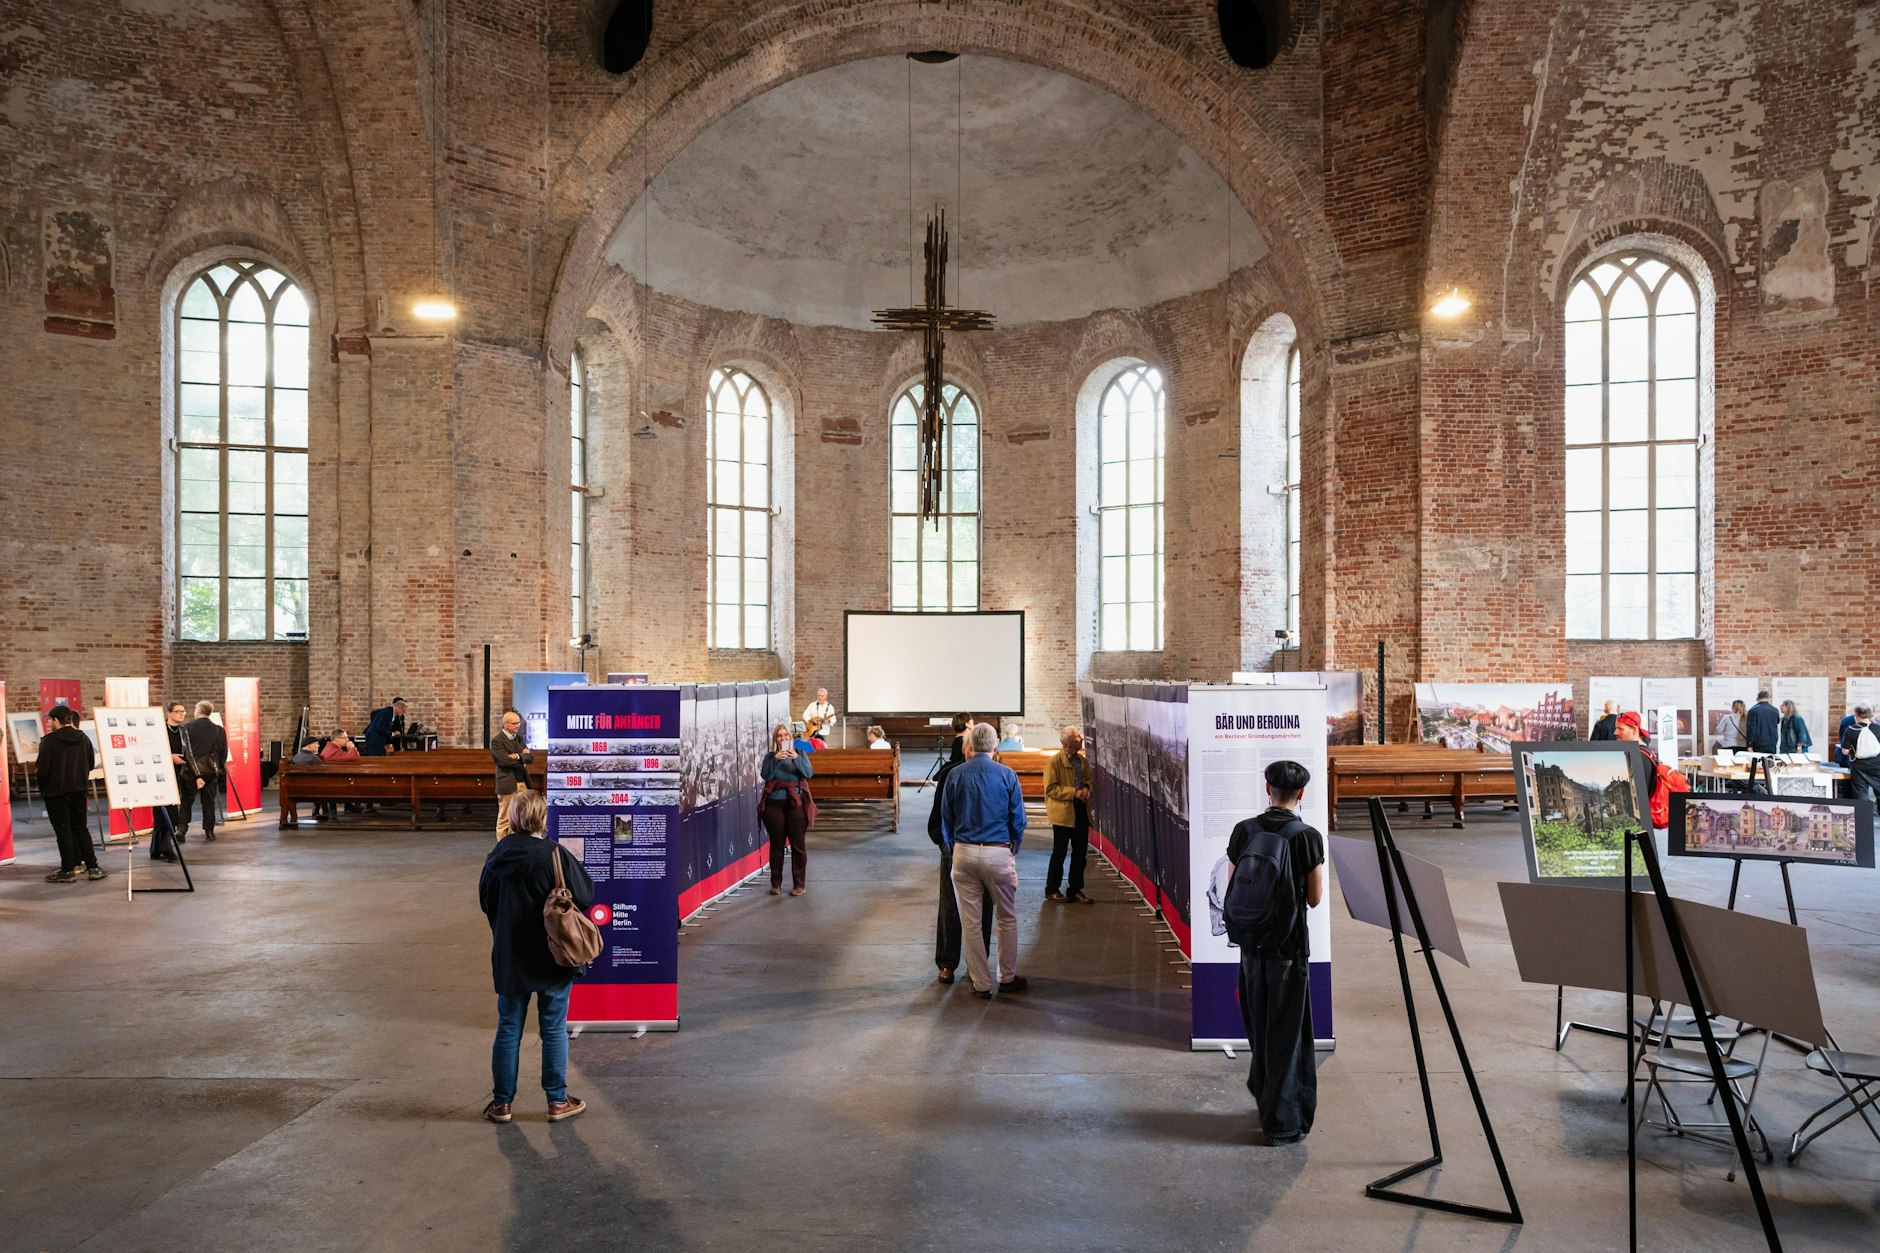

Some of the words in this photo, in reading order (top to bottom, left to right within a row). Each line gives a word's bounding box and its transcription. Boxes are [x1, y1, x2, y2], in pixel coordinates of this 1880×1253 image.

[567, 715, 594, 730] MITTE
[595, 712, 612, 730] FÜR
[614, 712, 661, 730] ANFÄNGER
[1215, 712, 1234, 730] BÄR
[1236, 715, 1255, 730] UND
[1257, 714, 1300, 730] BEROLINA
[592, 741, 608, 752] 1868
[644, 758, 659, 769] 1896
[566, 776, 582, 786] 1968
[611, 793, 629, 804] 2044
[612, 903, 637, 912] Stiftung
